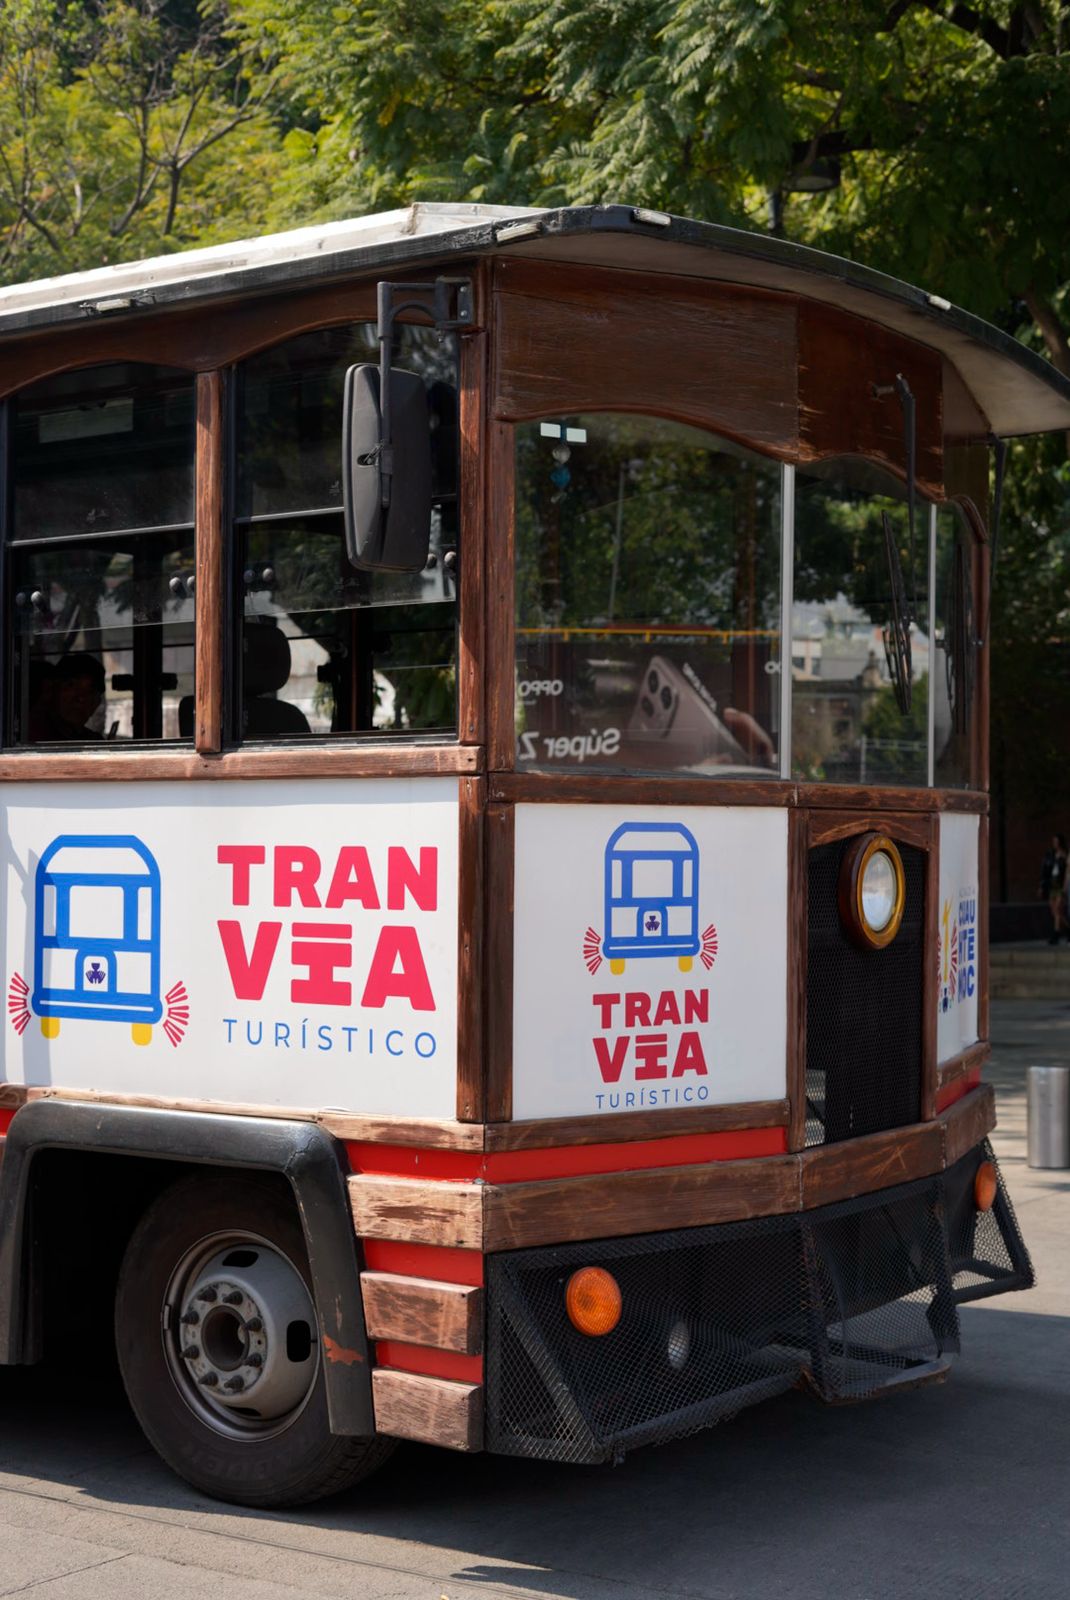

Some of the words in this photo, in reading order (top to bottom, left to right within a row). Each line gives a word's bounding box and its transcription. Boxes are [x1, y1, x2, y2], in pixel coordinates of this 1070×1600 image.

[217, 845, 438, 911] TRAN
[592, 989, 709, 1029] TRAN
[222, 1018, 437, 1059] TURÍSTICO
[595, 1085, 710, 1109] TURÍSTICO
